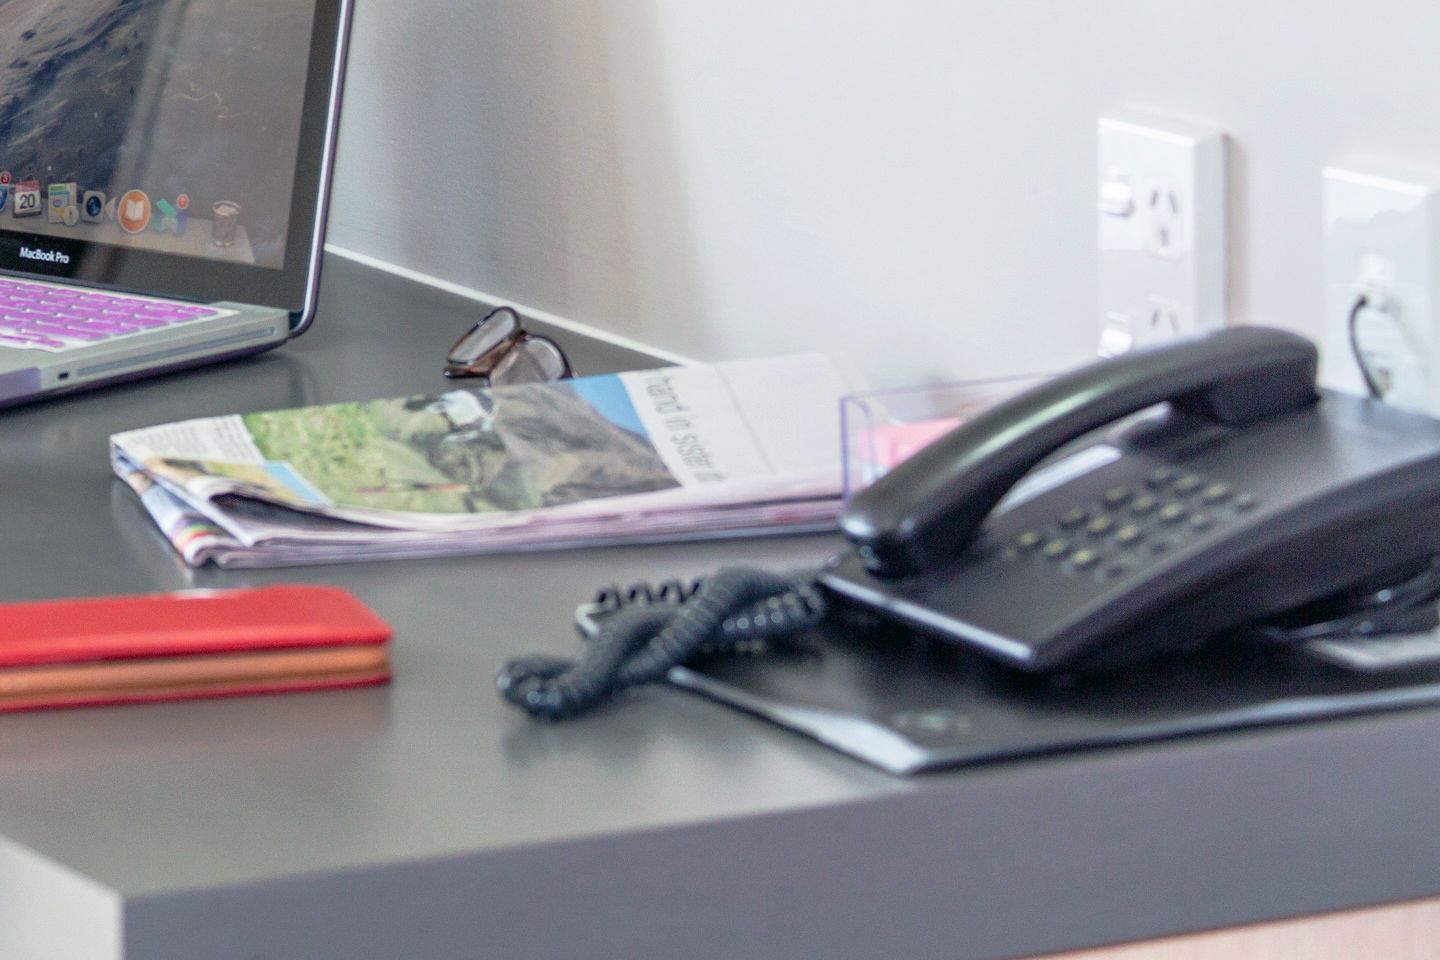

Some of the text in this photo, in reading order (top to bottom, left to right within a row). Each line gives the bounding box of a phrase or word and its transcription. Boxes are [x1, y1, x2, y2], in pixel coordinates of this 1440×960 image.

[20, 193, 35, 209] 20
[19, 247, 70, 264] MacBook Pro
